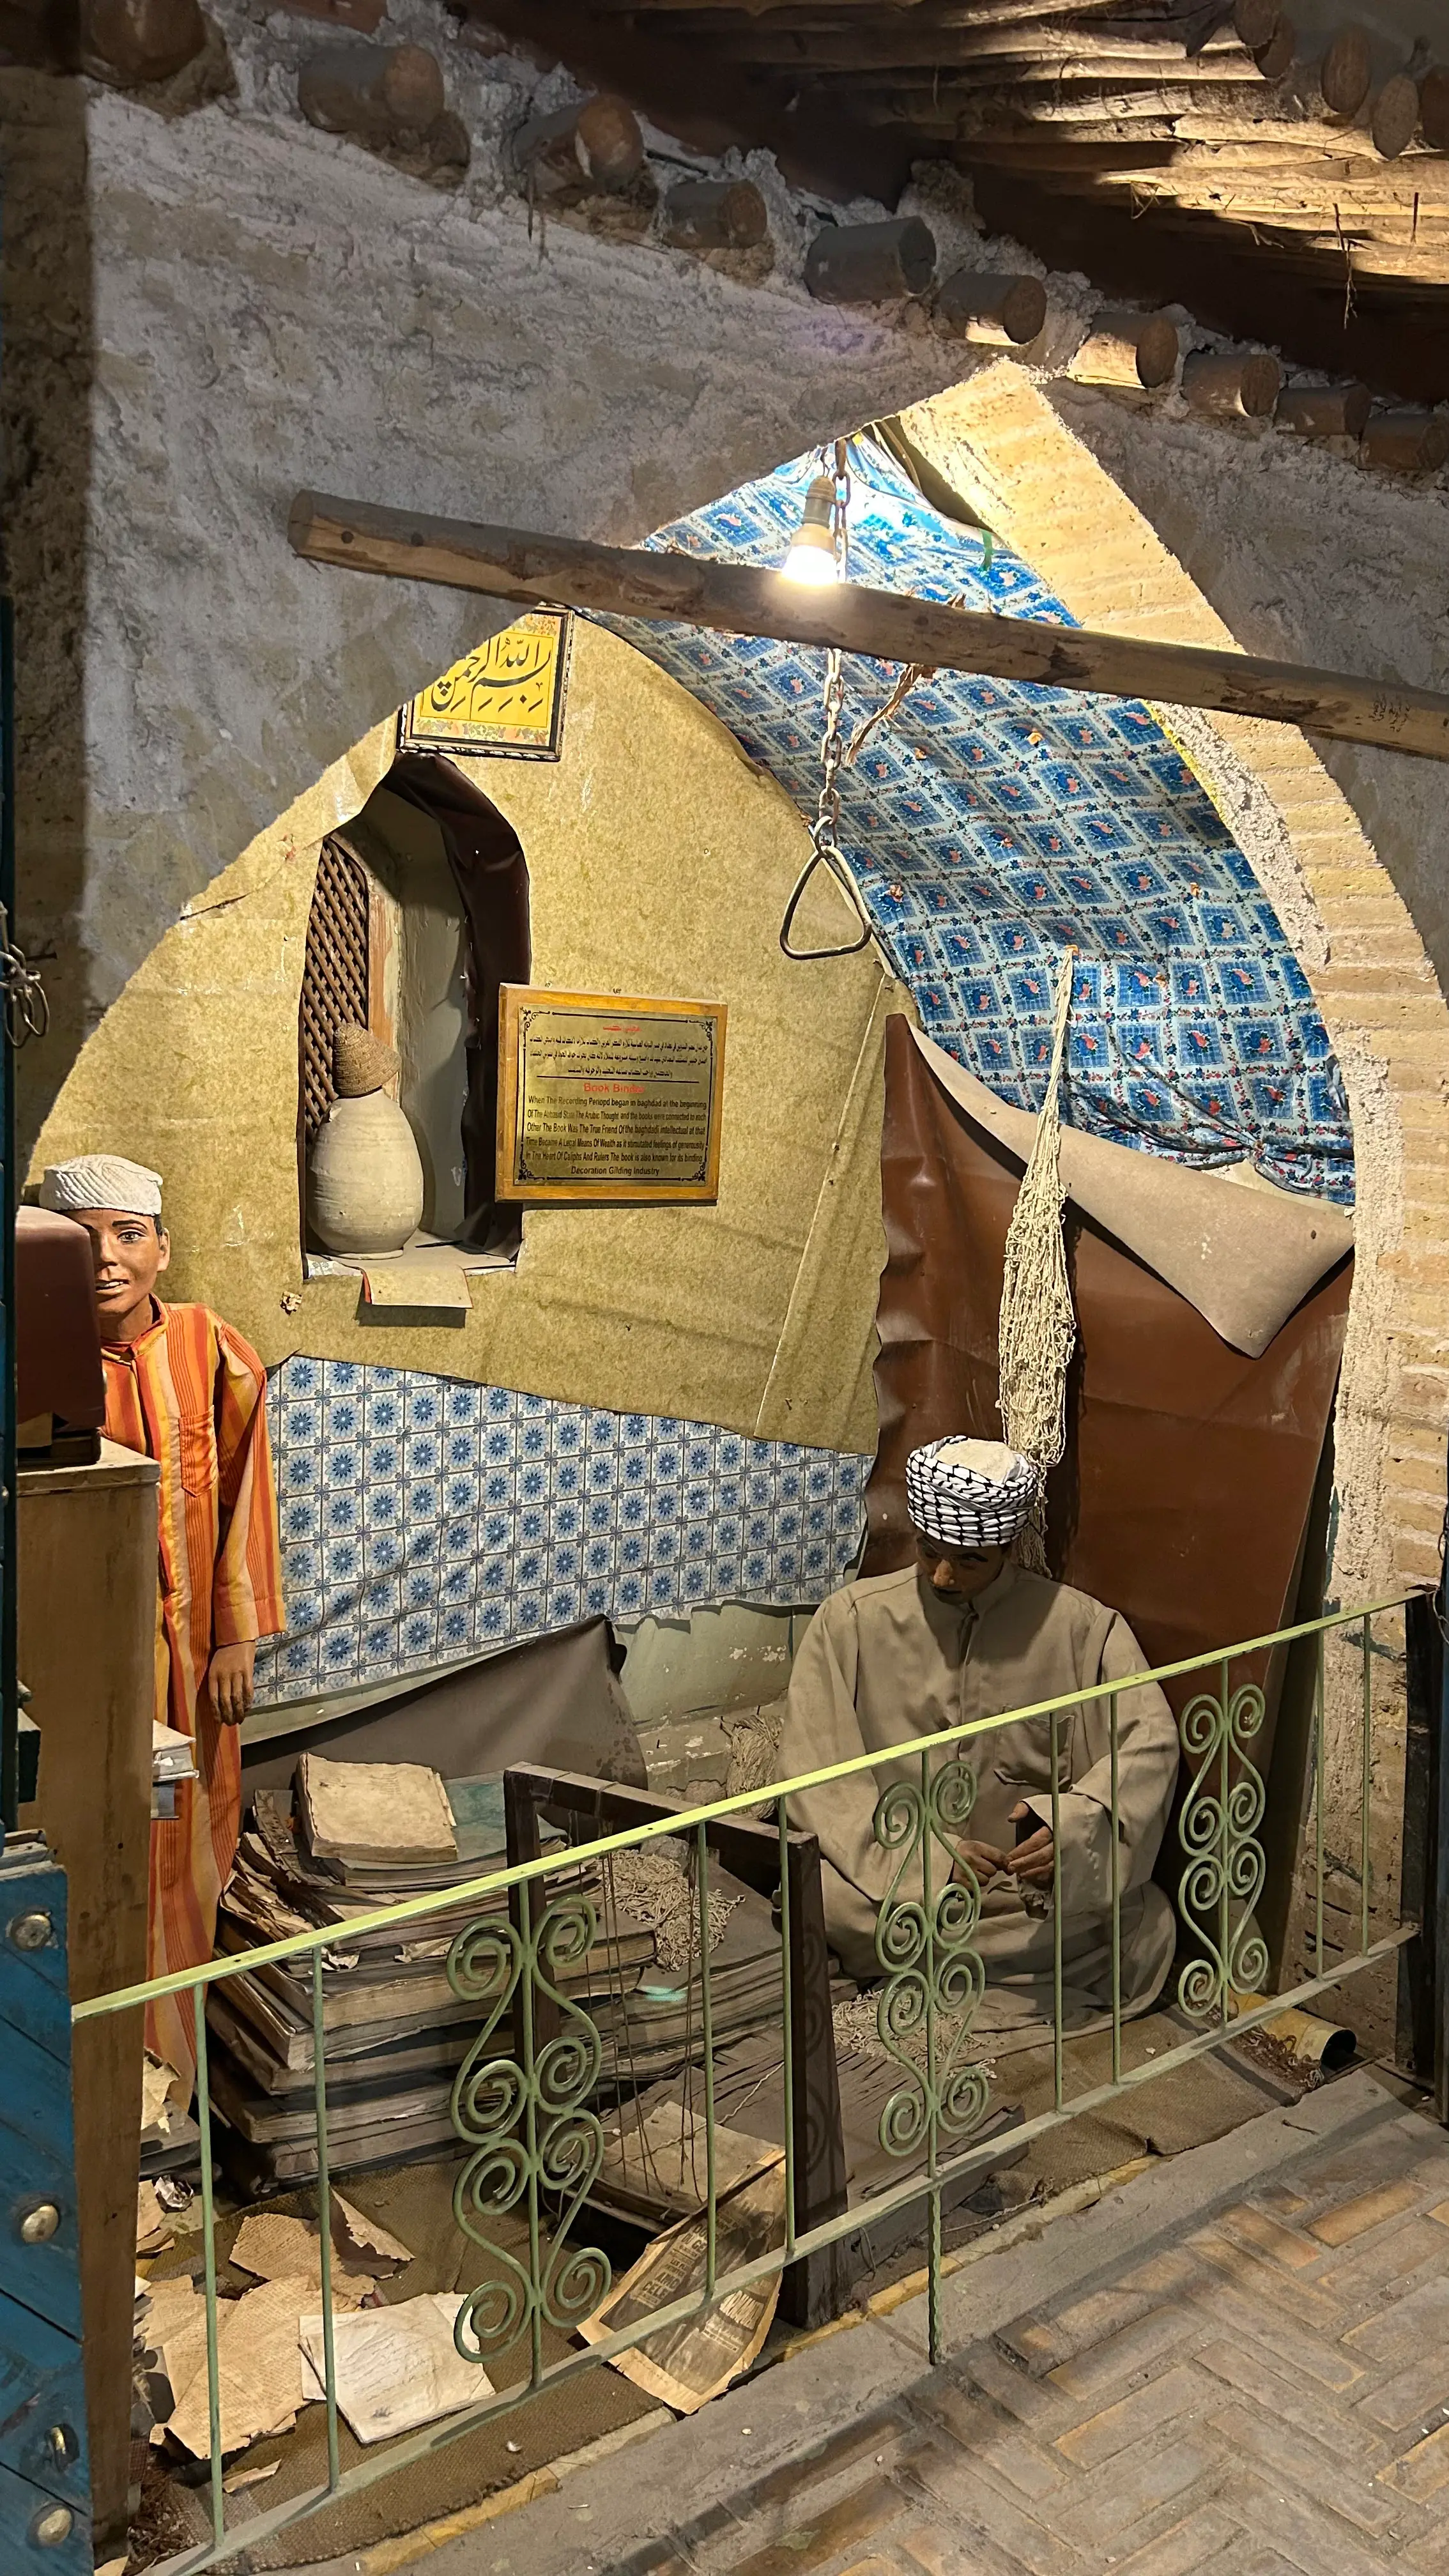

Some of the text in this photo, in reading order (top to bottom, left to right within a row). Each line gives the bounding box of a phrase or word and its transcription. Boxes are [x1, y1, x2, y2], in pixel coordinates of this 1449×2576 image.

[583, 1082, 610, 1092] Book
[528, 1095, 545, 1103] When
[547, 1096, 557, 1104] The
[558, 1096, 587, 1106] Recording
[611, 1099, 629, 1108] began
[637, 1099, 662, 1108] baghdad
[679, 1100, 707, 1110] beginning
[534, 1109, 543, 1118] The
[601, 1111, 619, 1122] Thought
[527, 1122, 541, 1131] Other
[543, 1123, 552, 1131] The
[553, 1123, 566, 1131] Book
[567, 1123, 578, 1133] Was
[579, 1124, 588, 1133] The
[590, 1124, 601, 1133] True
[602, 1124, 617, 1133] Friend
[695, 1126, 705, 1135] that
[577, 1138, 592, 1147] Means
[556, 1151, 564, 1161] Of
[583, 1152, 593, 1161] And
[594, 1152, 609, 1161] Rulers
[611, 1152, 619, 1162] The
[621, 1152, 633, 1162] book
[640, 1153, 652, 1162] also
[652, 1153, 669, 1162] known
[669, 1153, 677, 1162] for
[571, 1166, 660, 1176] Decoration Gilding Industry
